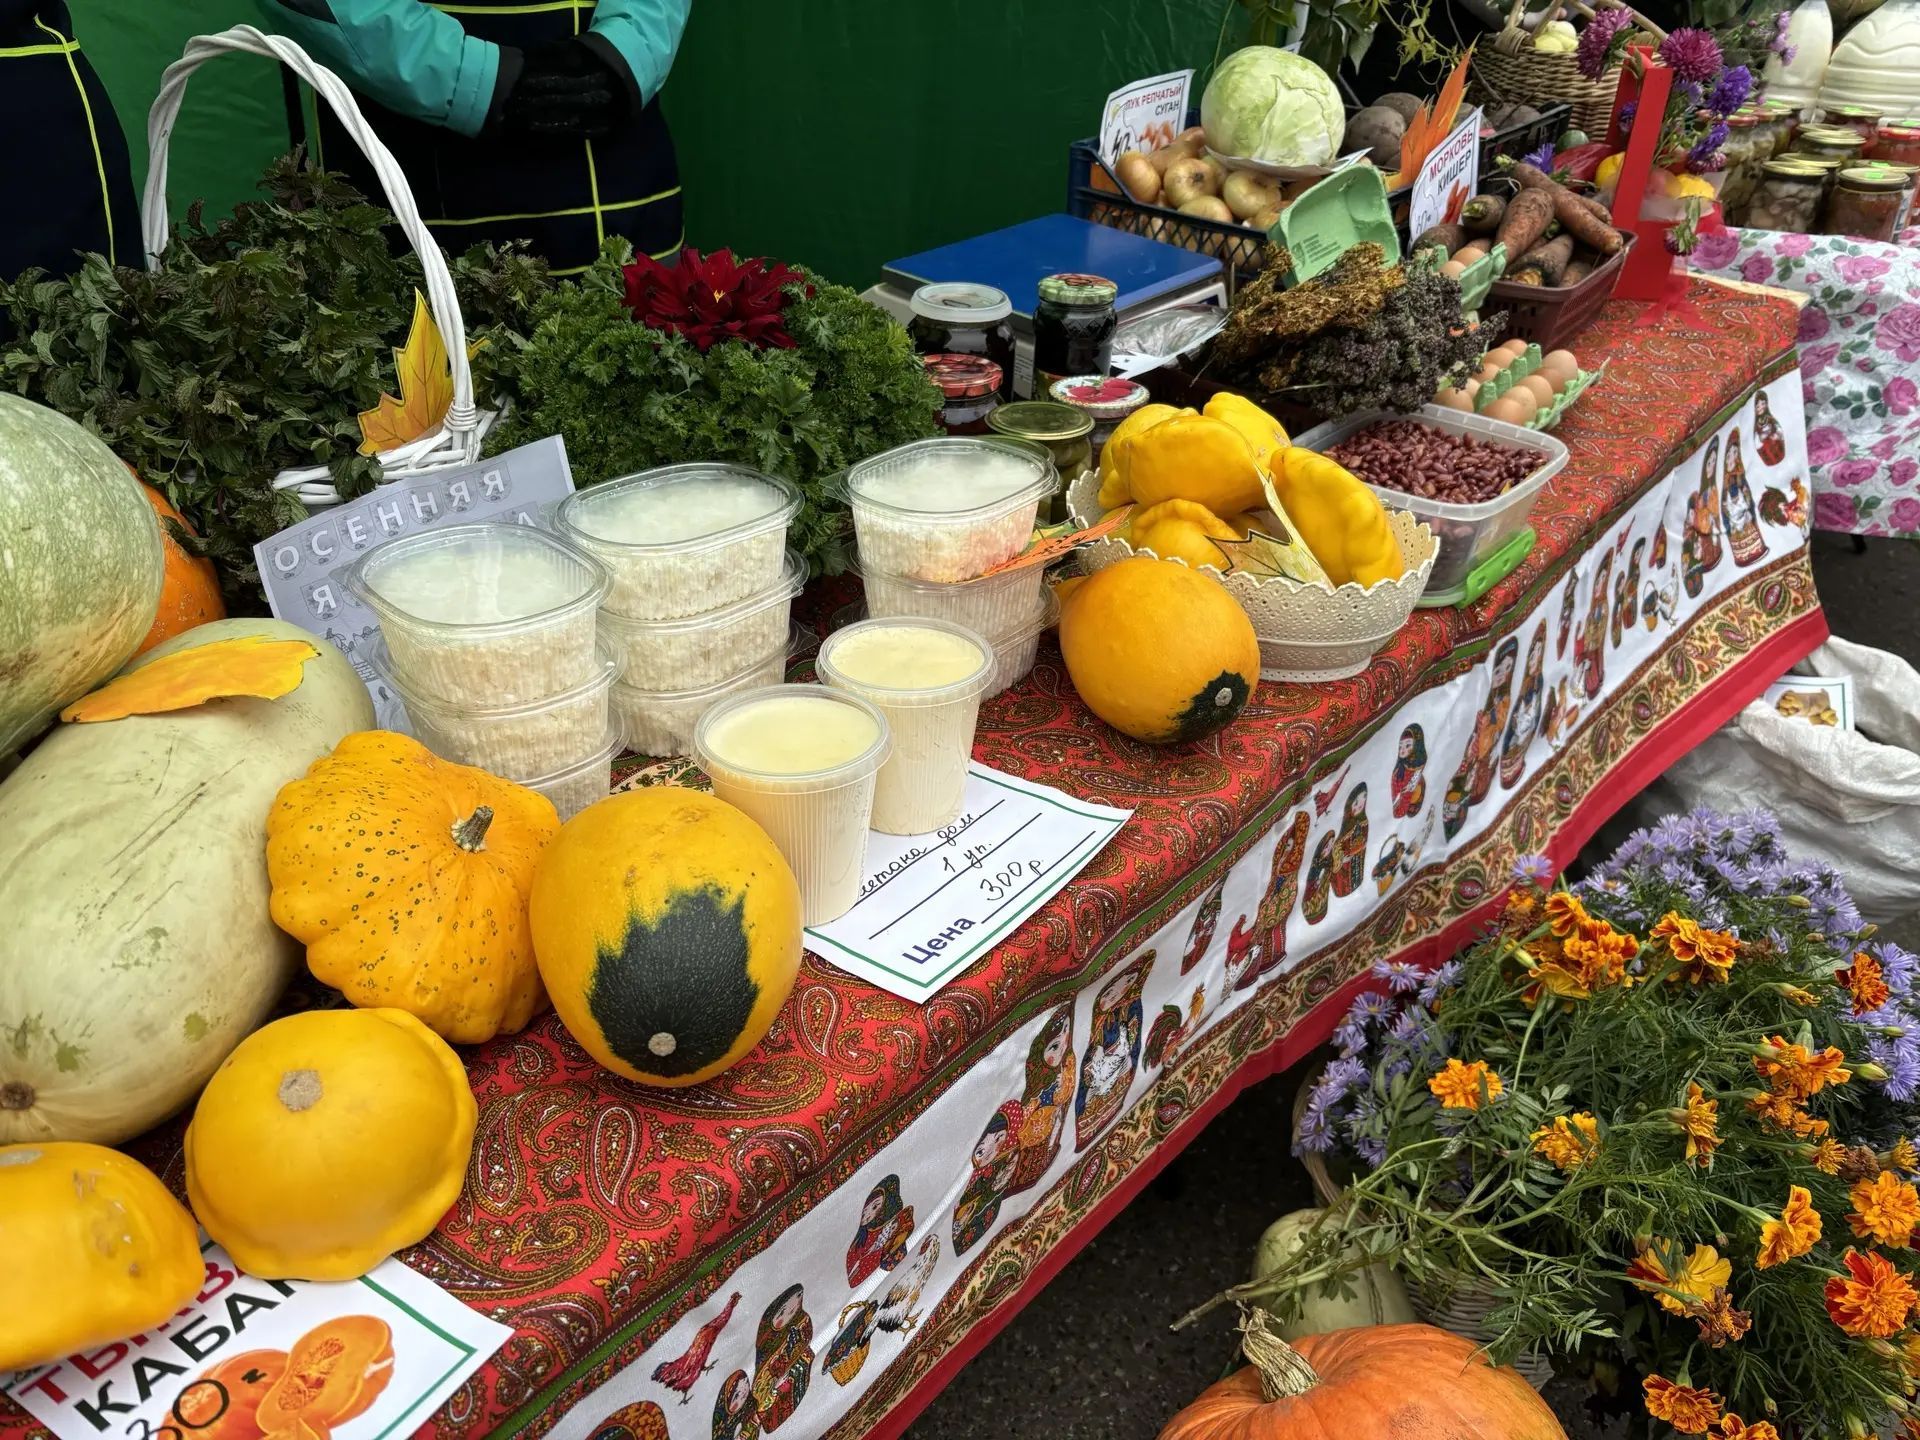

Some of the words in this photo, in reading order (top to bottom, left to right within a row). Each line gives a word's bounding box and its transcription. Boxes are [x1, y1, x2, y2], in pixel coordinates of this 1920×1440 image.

[1141, 84, 1183, 105] РЕПЧАТЫЙ
[1429, 129, 1473, 182] МОРКОВЬ
[1437, 149, 1471, 195] КИШЕР
[274, 469, 506, 572] ОСЕННЯЯ
[943, 856, 955, 873] 1
[902, 916, 976, 965] Цена
